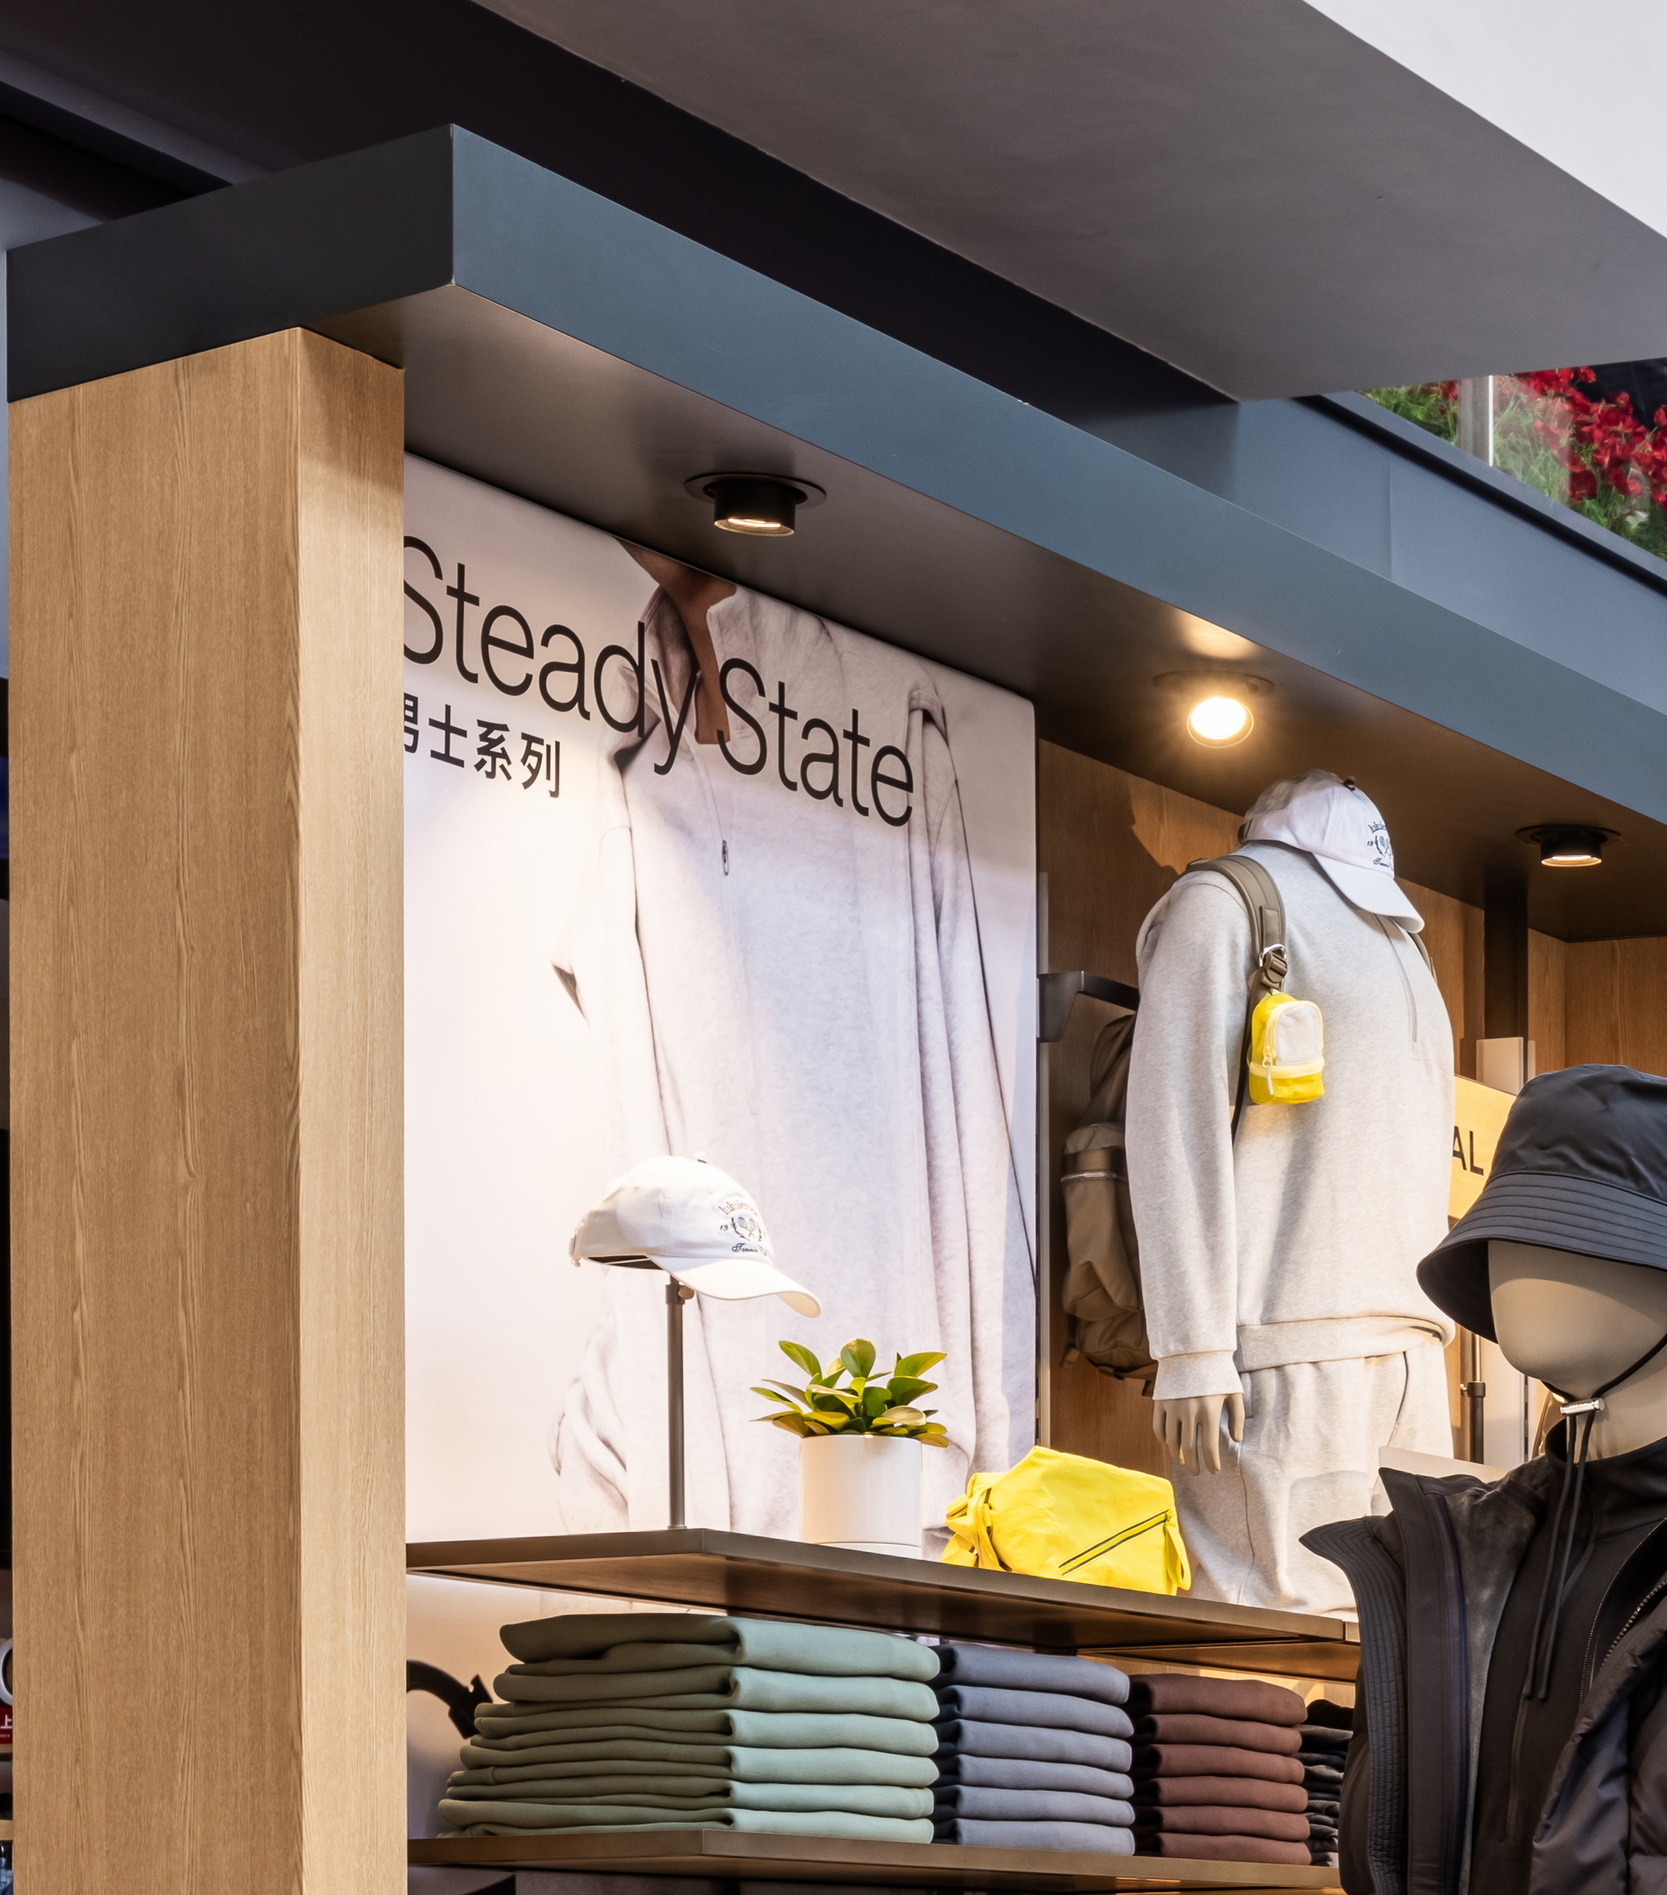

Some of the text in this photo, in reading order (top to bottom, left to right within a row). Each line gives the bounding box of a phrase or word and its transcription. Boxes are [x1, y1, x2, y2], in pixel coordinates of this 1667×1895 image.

[404, 535, 915, 828] Steady State
[404, 692, 562, 799] 男士系列
